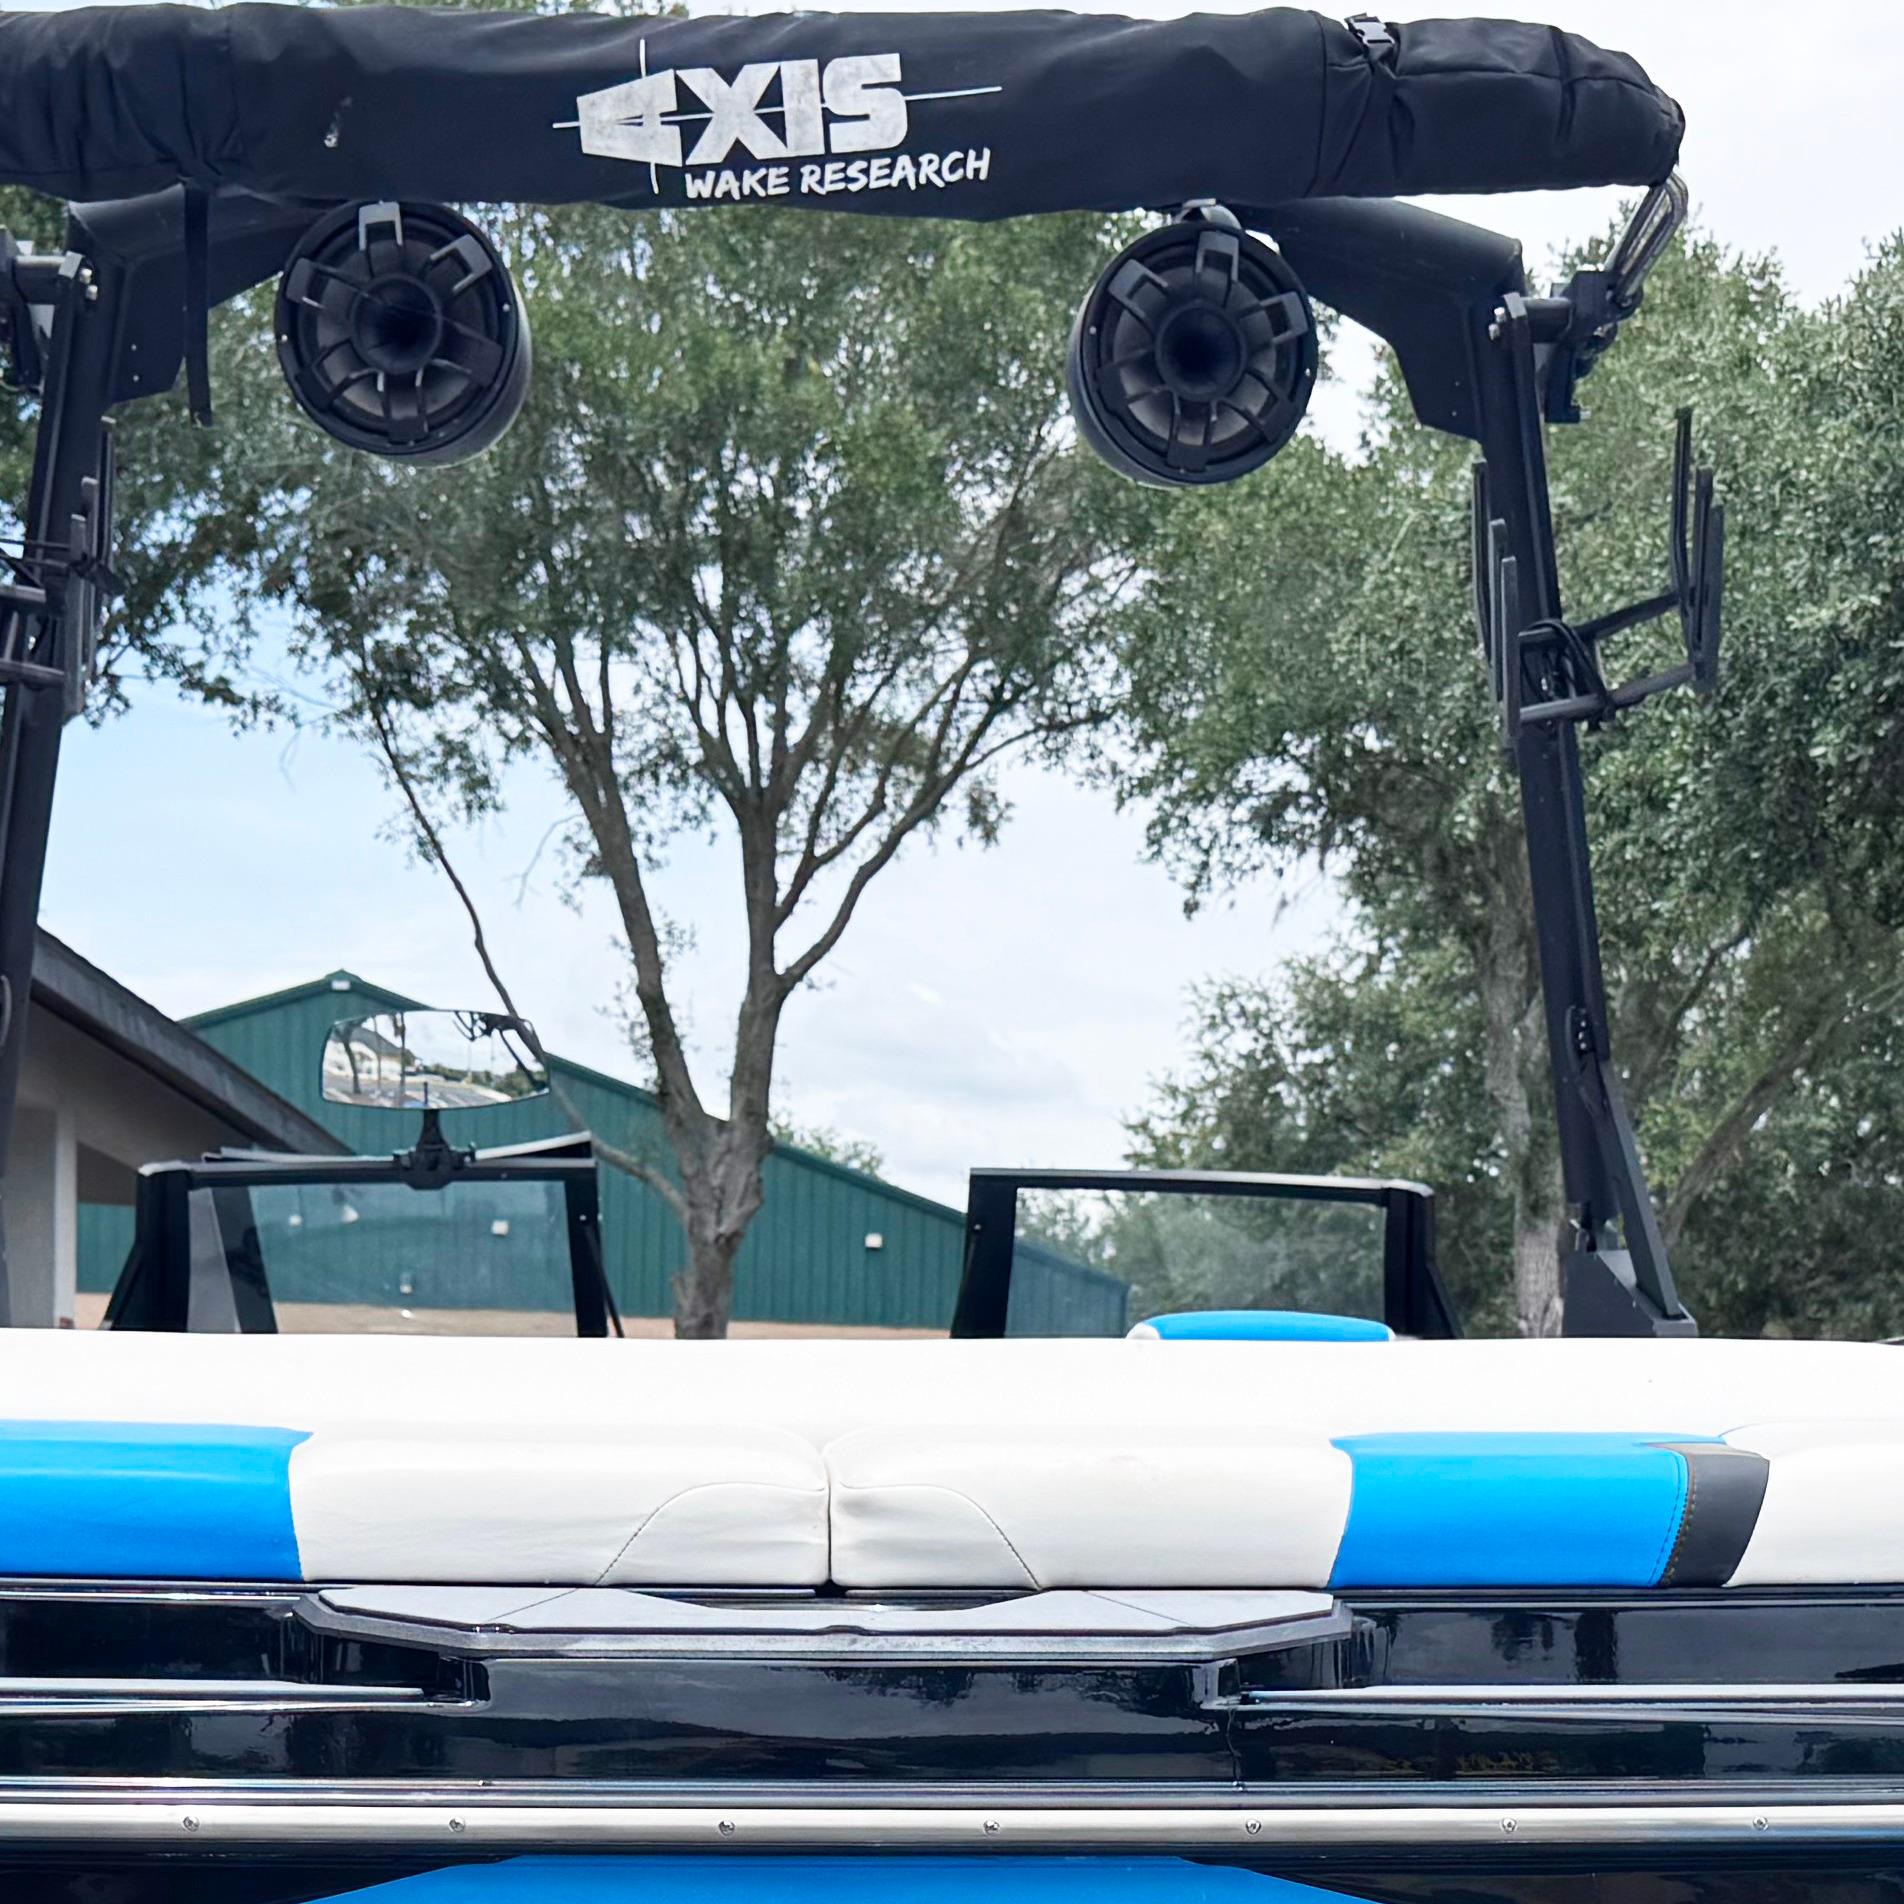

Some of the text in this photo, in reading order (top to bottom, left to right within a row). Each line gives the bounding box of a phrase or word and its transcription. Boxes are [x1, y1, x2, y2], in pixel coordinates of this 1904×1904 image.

[576, 53, 908, 167] AXIS
[685, 147, 991, 200] WAKE RESEARCH
